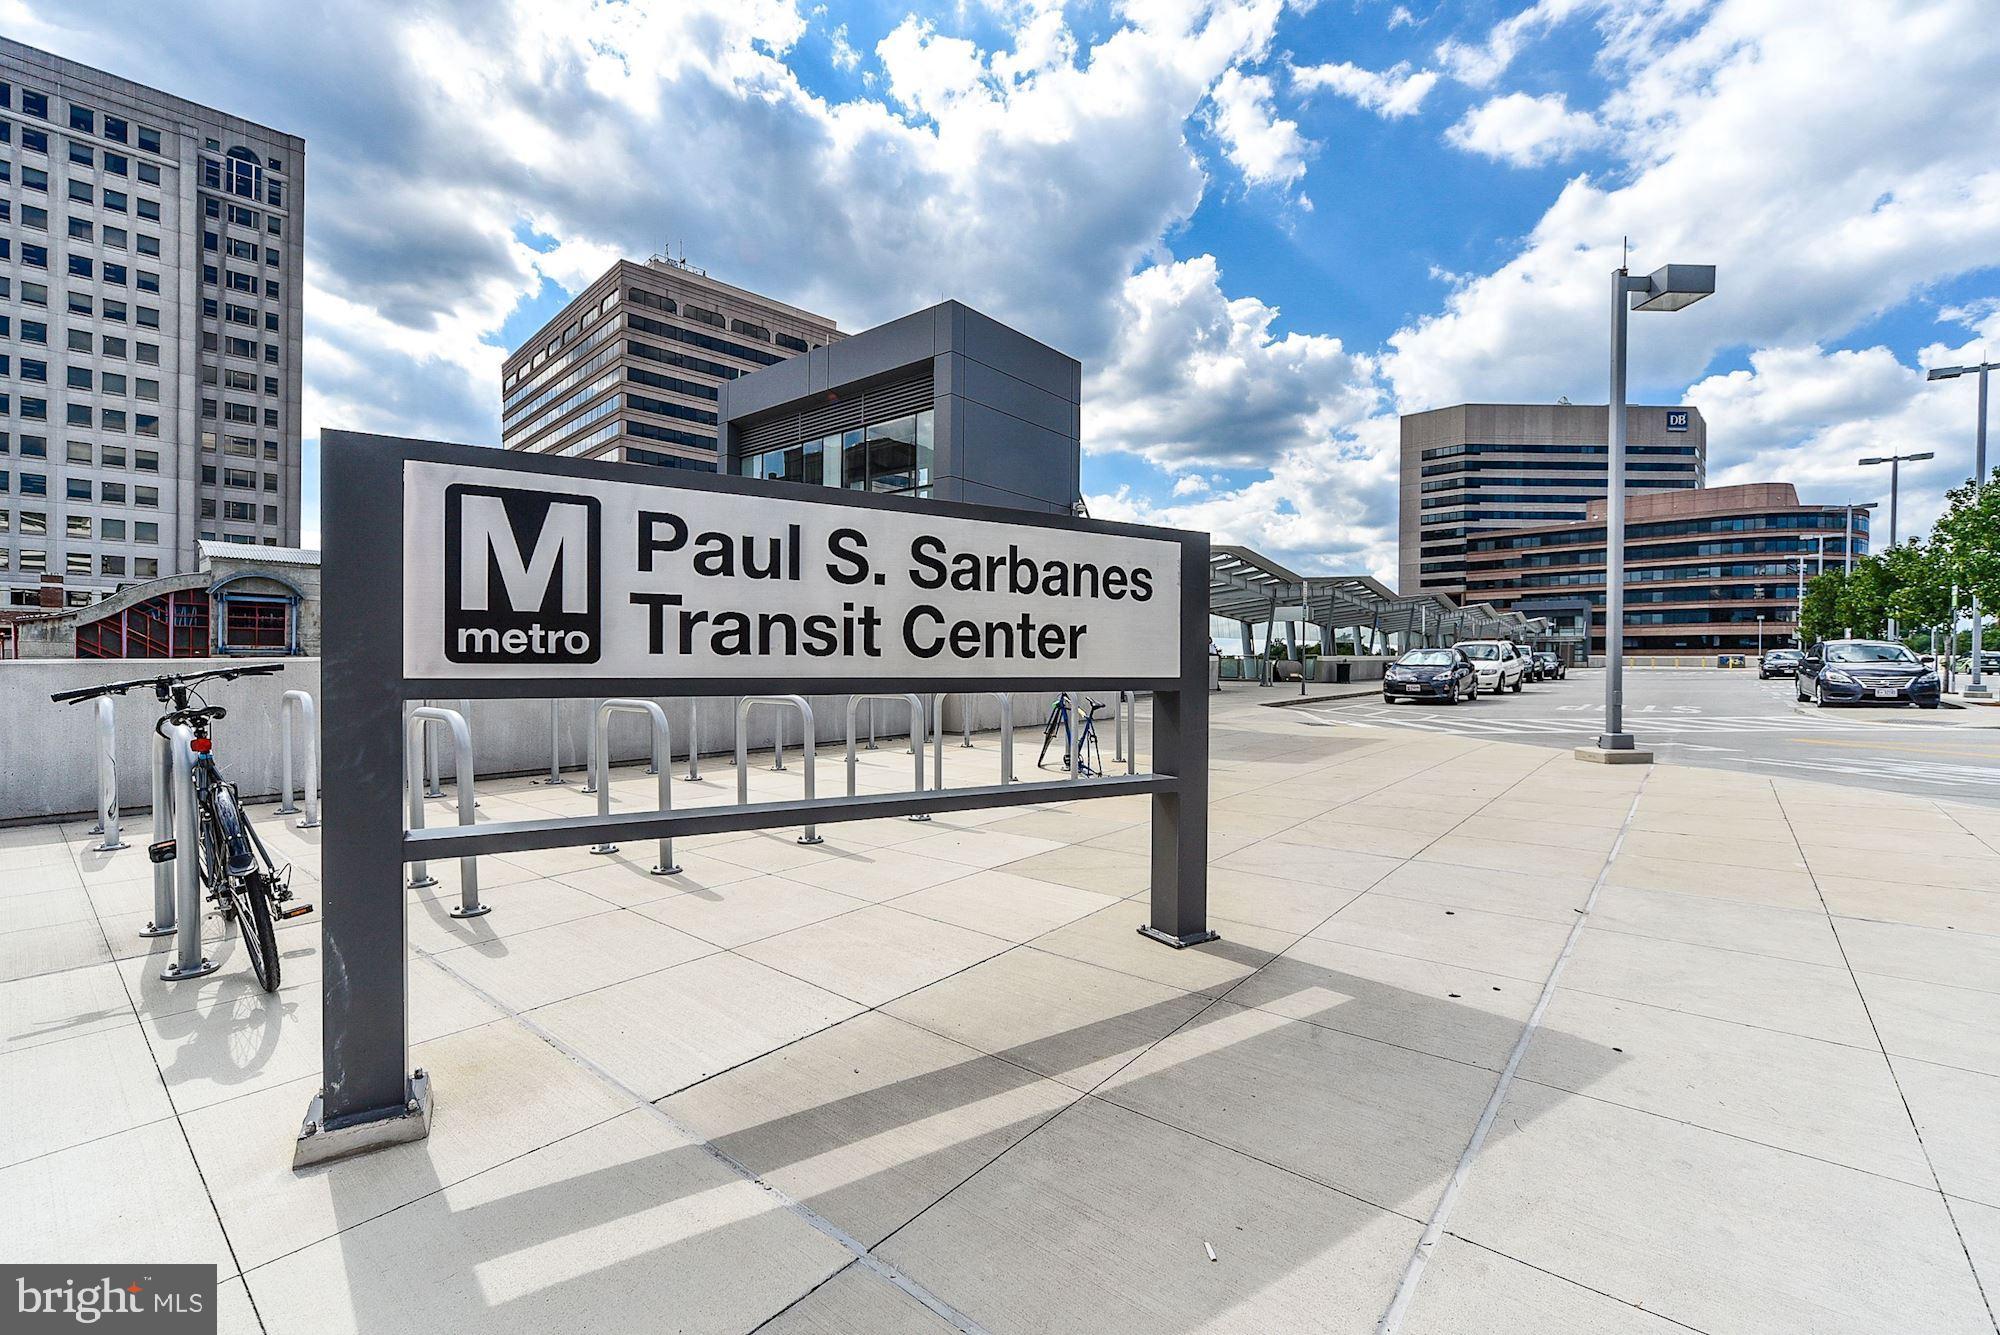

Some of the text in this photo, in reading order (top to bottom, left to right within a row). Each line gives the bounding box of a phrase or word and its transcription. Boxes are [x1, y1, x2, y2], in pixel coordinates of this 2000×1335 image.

[1670, 414, 1687, 426] DB
[460, 493, 588, 614] M
[637, 510, 1154, 602] Paul S. Sarbanes
[458, 623, 590, 655] metro
[629, 592, 1088, 660] Transit Center
